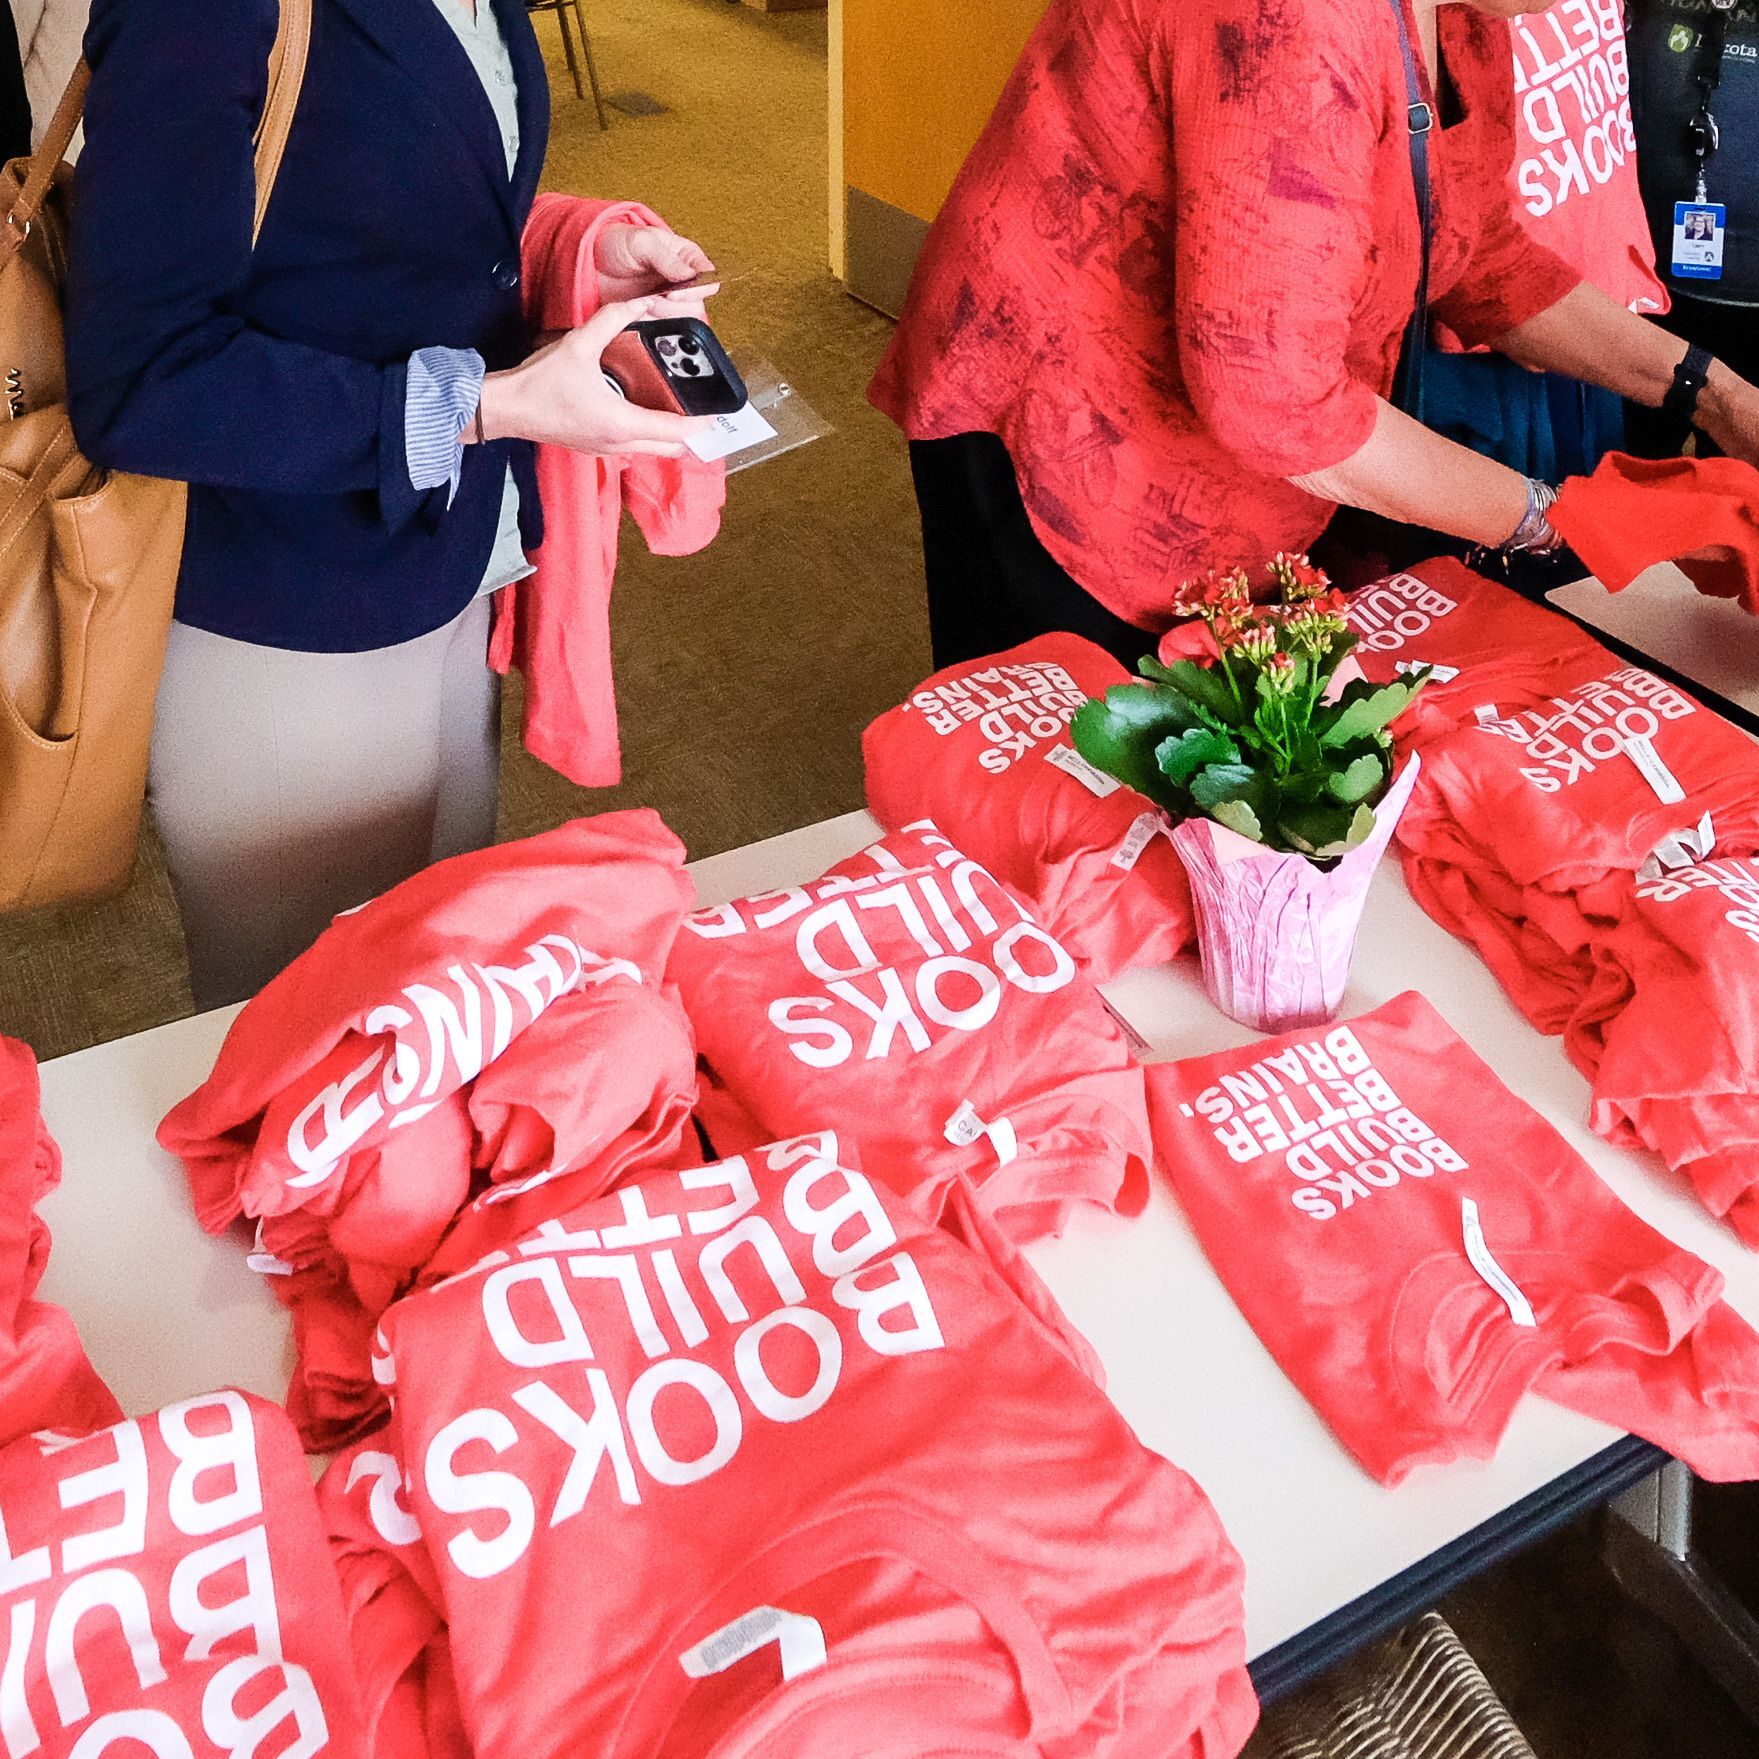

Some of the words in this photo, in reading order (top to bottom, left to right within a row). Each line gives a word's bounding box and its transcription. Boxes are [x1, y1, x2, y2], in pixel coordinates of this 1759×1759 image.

[1523, 40, 1629, 144] BUILD
[1356, 590, 1458, 654] BOO
[925, 667, 1078, 735] BETTER
[1519, 689, 1696, 793] BOOKS
[1526, 674, 1668, 760] BUILD
[795, 861, 1037, 983] UILD
[768, 922, 1076, 1069] OOKS
[1213, 1069, 1402, 1163] BETTER
[1285, 1107, 1436, 1182] BUILD
[1290, 1137, 1469, 1221] BOOKS
[483, 1161, 898, 1368] BUILD
[426, 1253, 944, 1579] BOOKS
